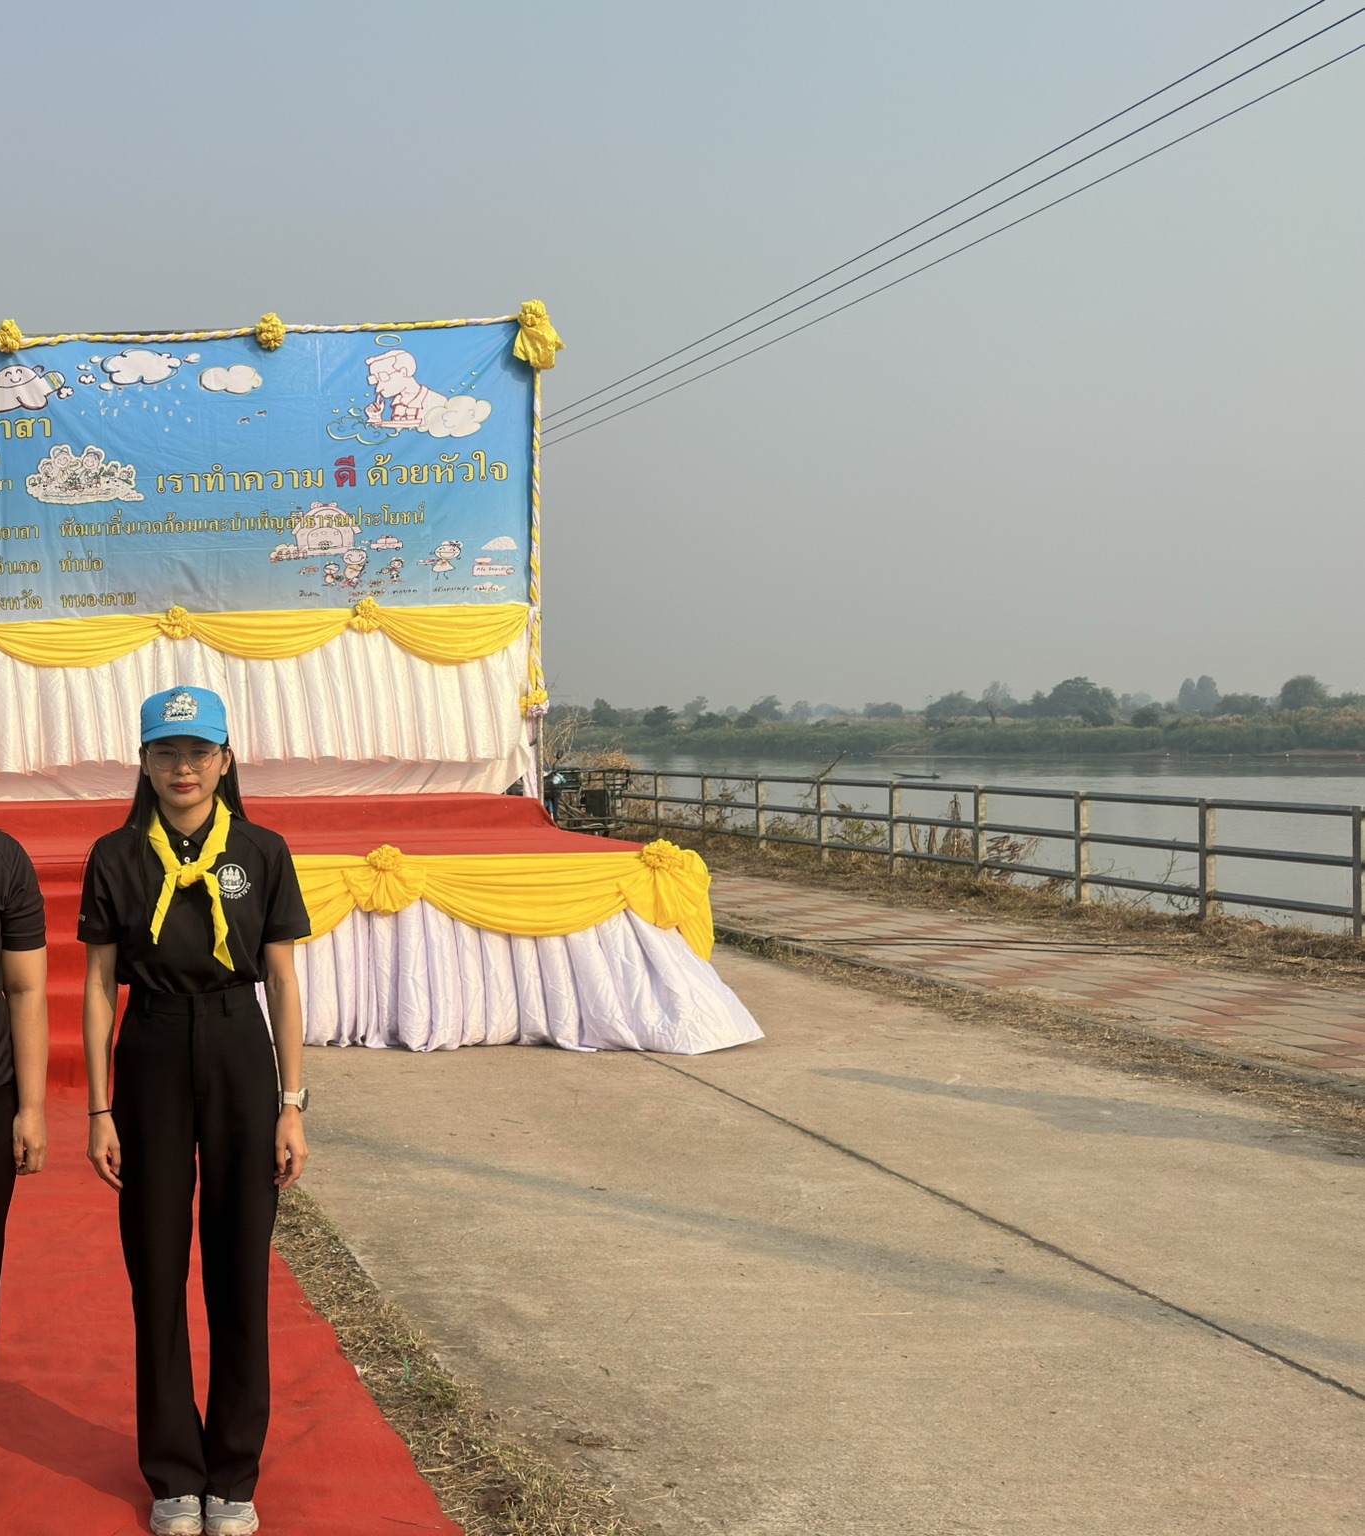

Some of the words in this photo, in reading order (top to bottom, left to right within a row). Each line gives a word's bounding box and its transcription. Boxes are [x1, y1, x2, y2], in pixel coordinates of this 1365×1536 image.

[156, 463, 324, 494] เราทำความ
[334, 455, 356, 488] ดี
[367, 450, 509, 487] ด้วยหัวใจ
[59, 550, 104, 573] ท่าบ่อ
[60, 591, 136, 609] หนองคาย
